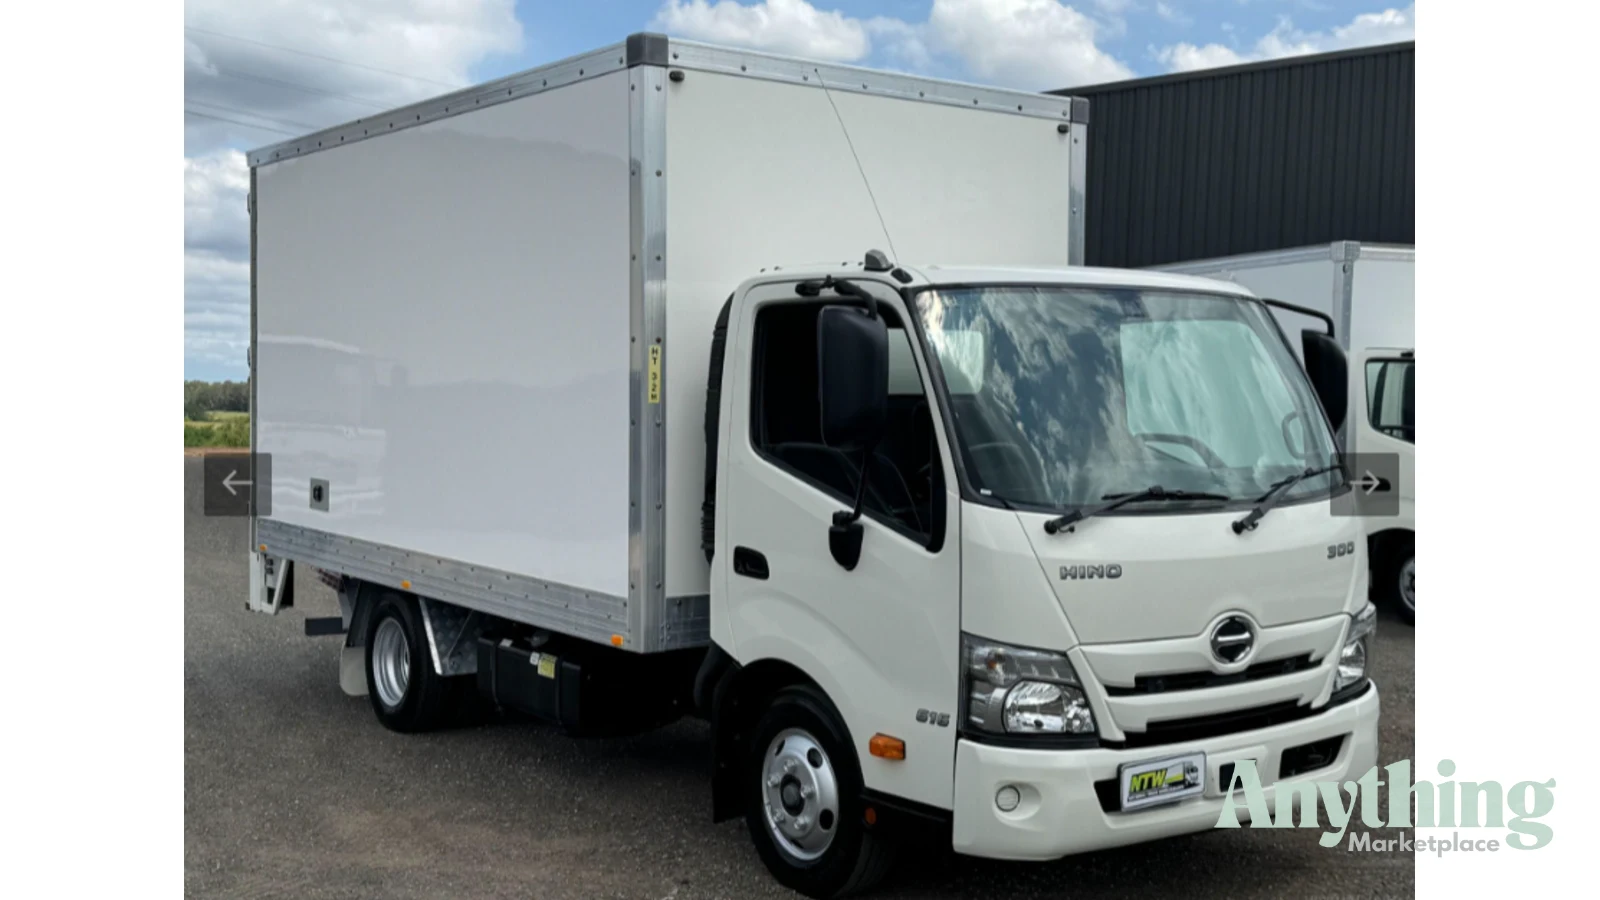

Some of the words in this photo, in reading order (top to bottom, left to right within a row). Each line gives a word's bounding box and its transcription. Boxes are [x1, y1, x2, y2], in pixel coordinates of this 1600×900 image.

[1327, 541, 1355, 560] 300
[1059, 564, 1123, 580] HINO
[915, 708, 951, 728] 616
[1129, 768, 1168, 793] NTW
